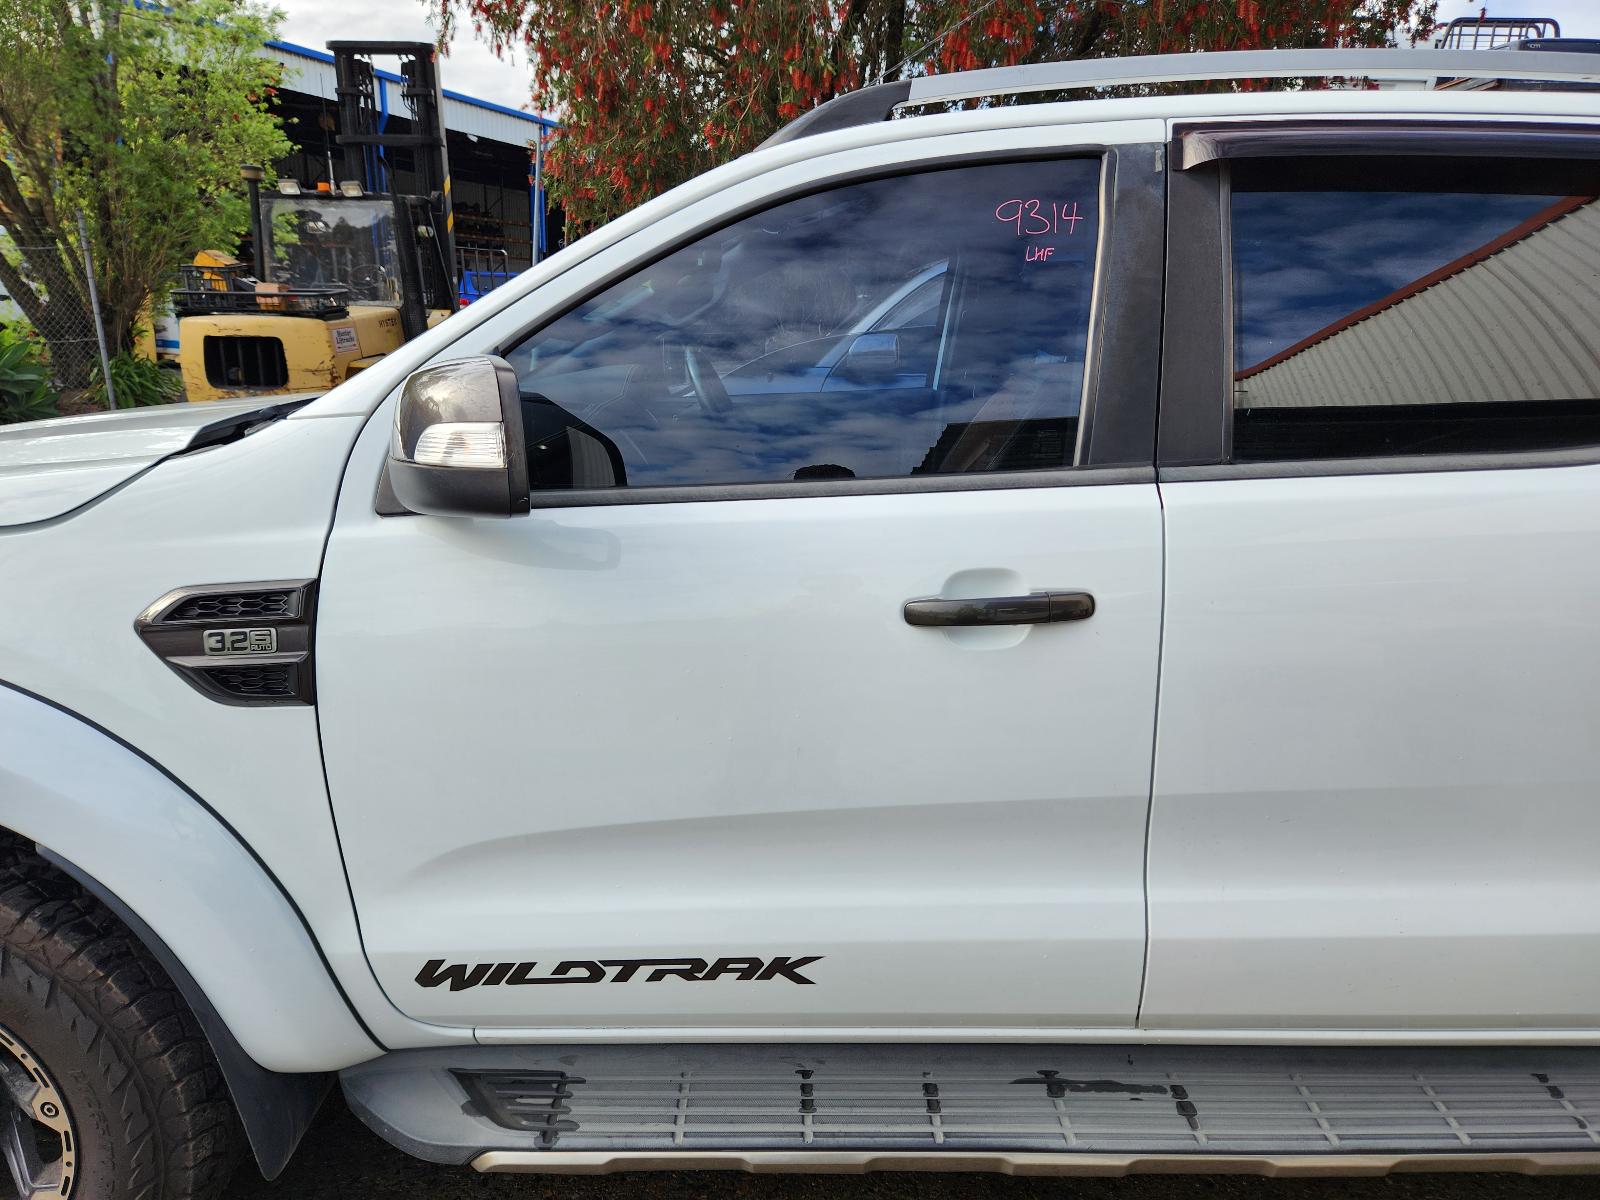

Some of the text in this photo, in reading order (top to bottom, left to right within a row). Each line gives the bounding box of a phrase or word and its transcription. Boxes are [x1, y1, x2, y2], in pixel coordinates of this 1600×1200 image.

[995, 199, 1084, 236] 9314
[1025, 245, 1055, 262] LHF
[207, 630, 249, 652] 3.2
[250, 643, 272, 651] AUTO
[414, 955, 826, 992] WILDTRAK
